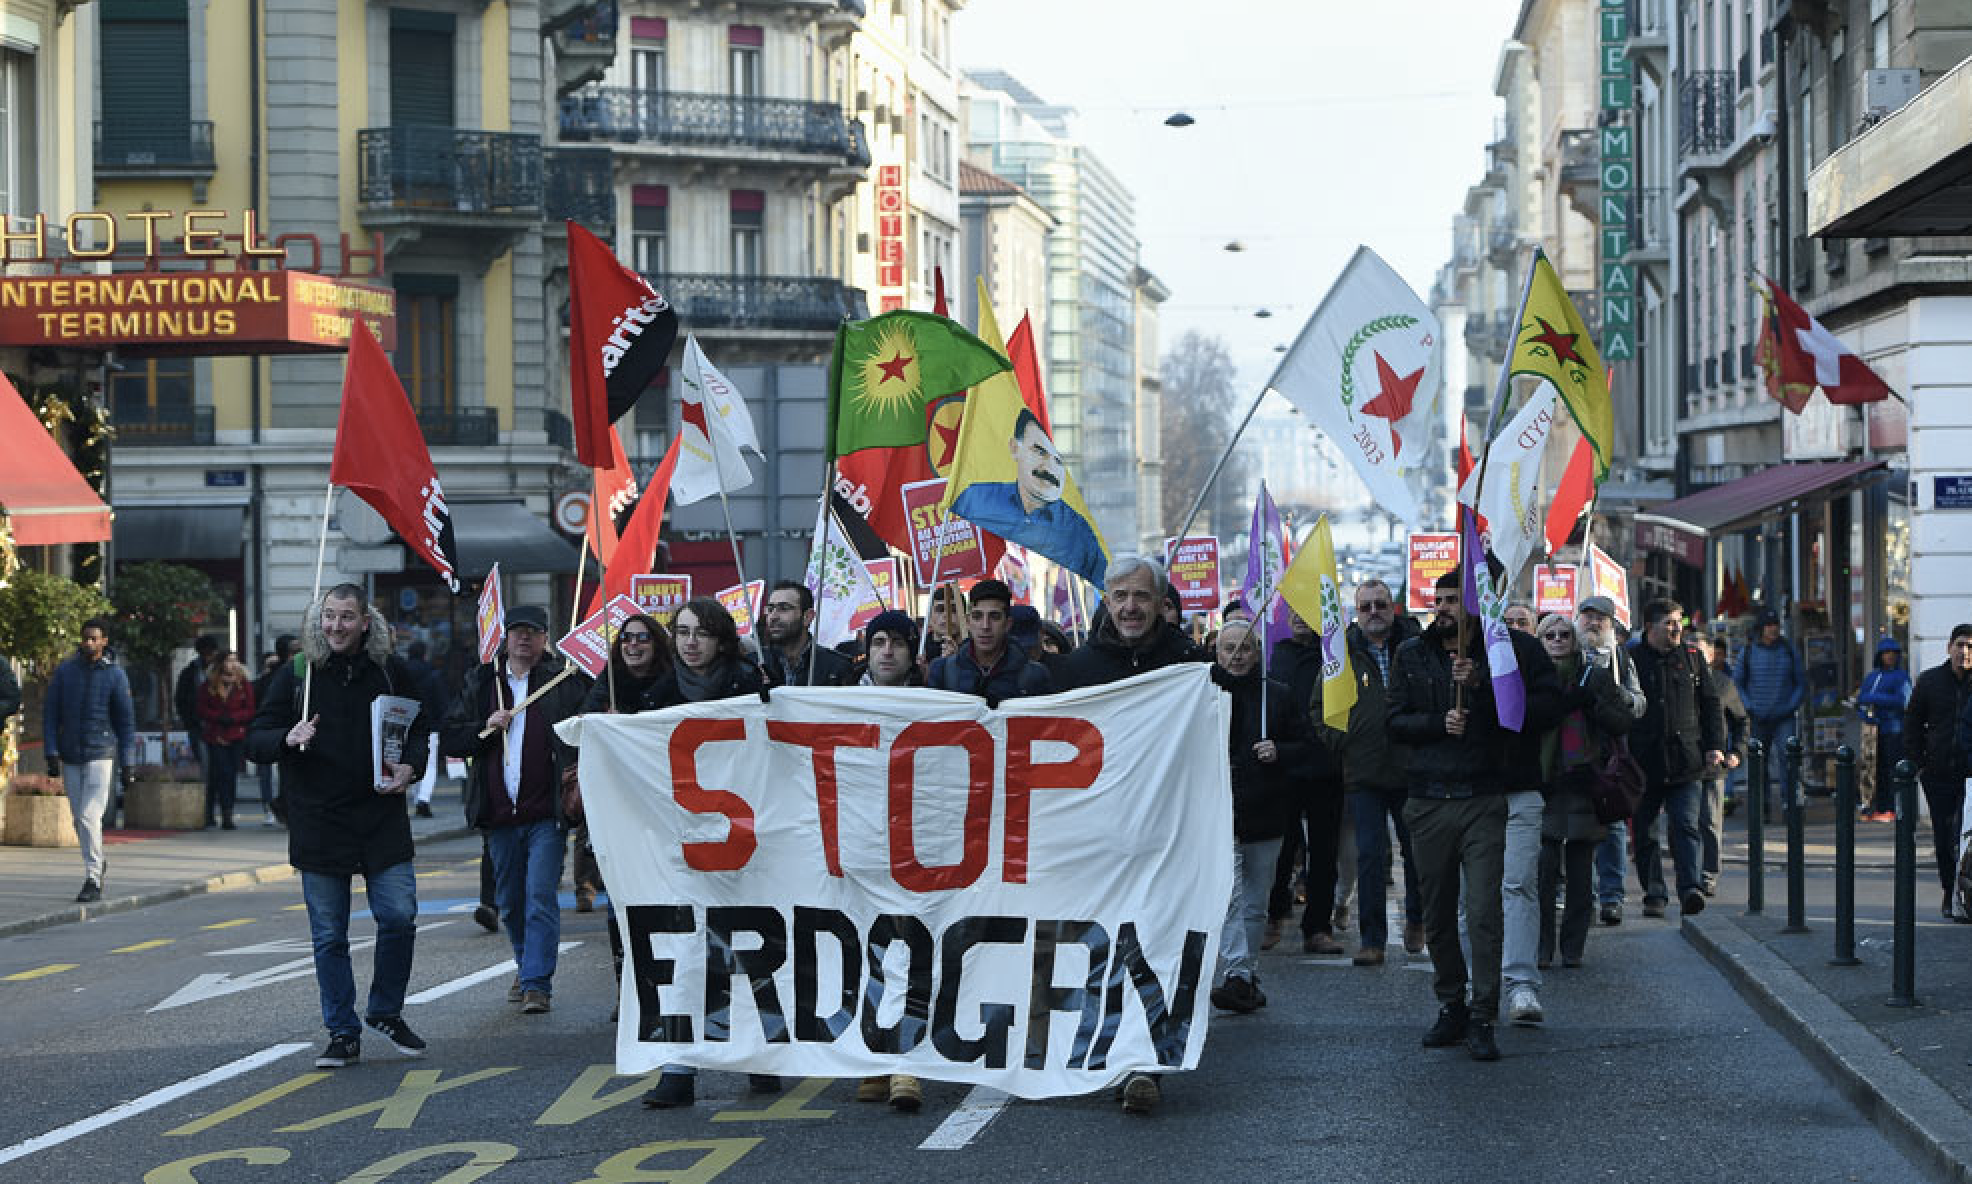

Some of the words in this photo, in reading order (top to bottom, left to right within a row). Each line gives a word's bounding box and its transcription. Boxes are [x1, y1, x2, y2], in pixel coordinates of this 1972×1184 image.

[1604, 0, 1628, 107] TEL
[0, 209, 286, 260] HOTEL
[880, 166, 902, 286] HOTEL
[1603, 131, 1629, 357] MONTANA
[1, 278, 281, 307] NTERNATIONAL
[37, 310, 236, 338] TERMINUS
[668, 717, 1104, 892] STOP
[626, 905, 1208, 1070] ERDOGAN
